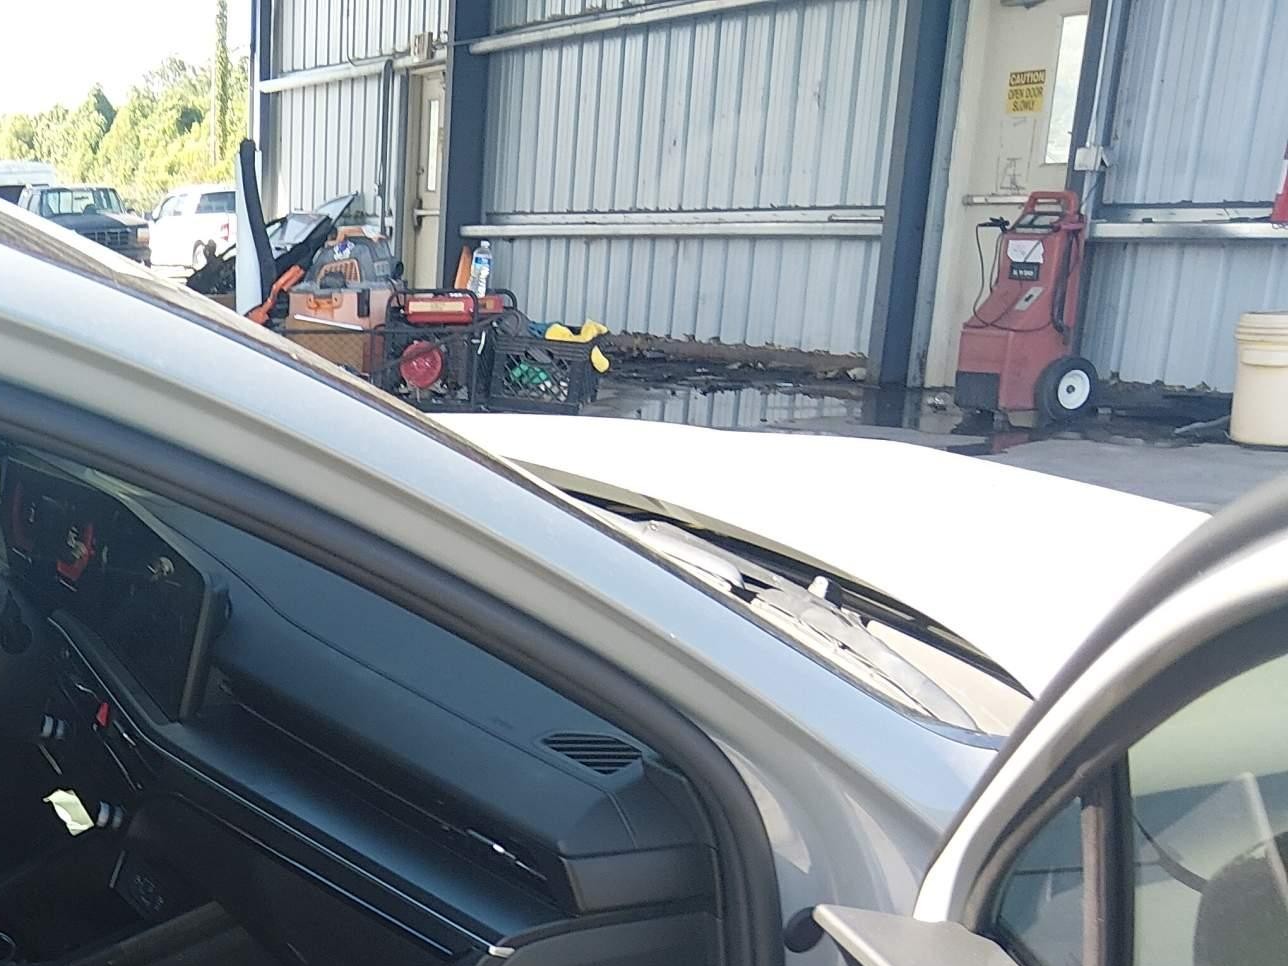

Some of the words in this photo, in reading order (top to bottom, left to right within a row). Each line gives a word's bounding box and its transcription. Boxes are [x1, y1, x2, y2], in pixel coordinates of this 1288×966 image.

[1011, 71, 1045, 85] CAUTION
[1008, 88, 1024, 100] OPEN
[1025, 86, 1043, 98] DOOR
